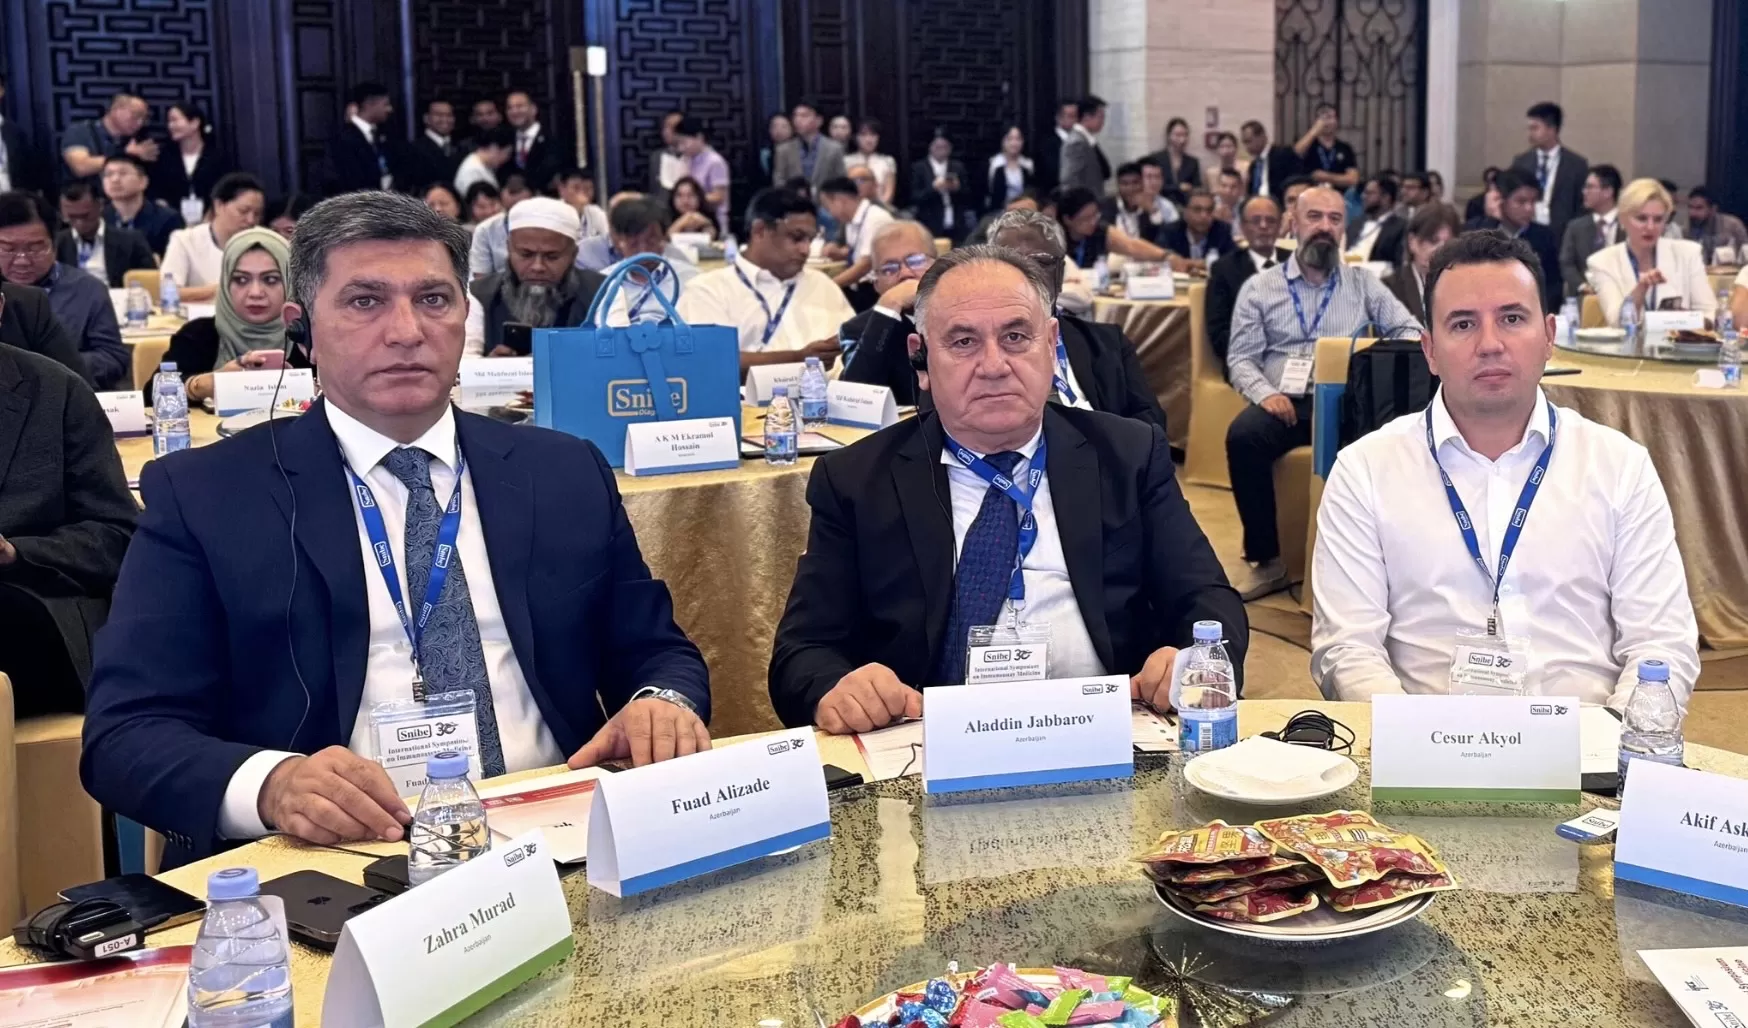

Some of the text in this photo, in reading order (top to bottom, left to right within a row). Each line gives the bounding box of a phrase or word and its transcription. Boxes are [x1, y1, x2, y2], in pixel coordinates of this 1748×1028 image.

[615, 387, 681, 409] Snie
[671, 433, 679, 441] M
[964, 713, 1095, 734] Aladdin Jabbarov
[400, 728, 429, 739] Snibe
[1015, 734, 1047, 744] Azerbaijan
[1430, 730, 1522, 748] Cesur Akyol
[388, 742, 431, 754] International
[1460, 750, 1492, 760] Azerbaijan
[671, 777, 771, 815] Fuad Alizade
[709, 806, 741, 821] Azerbaijan
[1680, 811, 1718, 831] Akif
[423, 892, 516, 955] Zahra Murad
[103, 937, 131, 953] A-051
[463, 933, 492, 955] Azerbaijan
